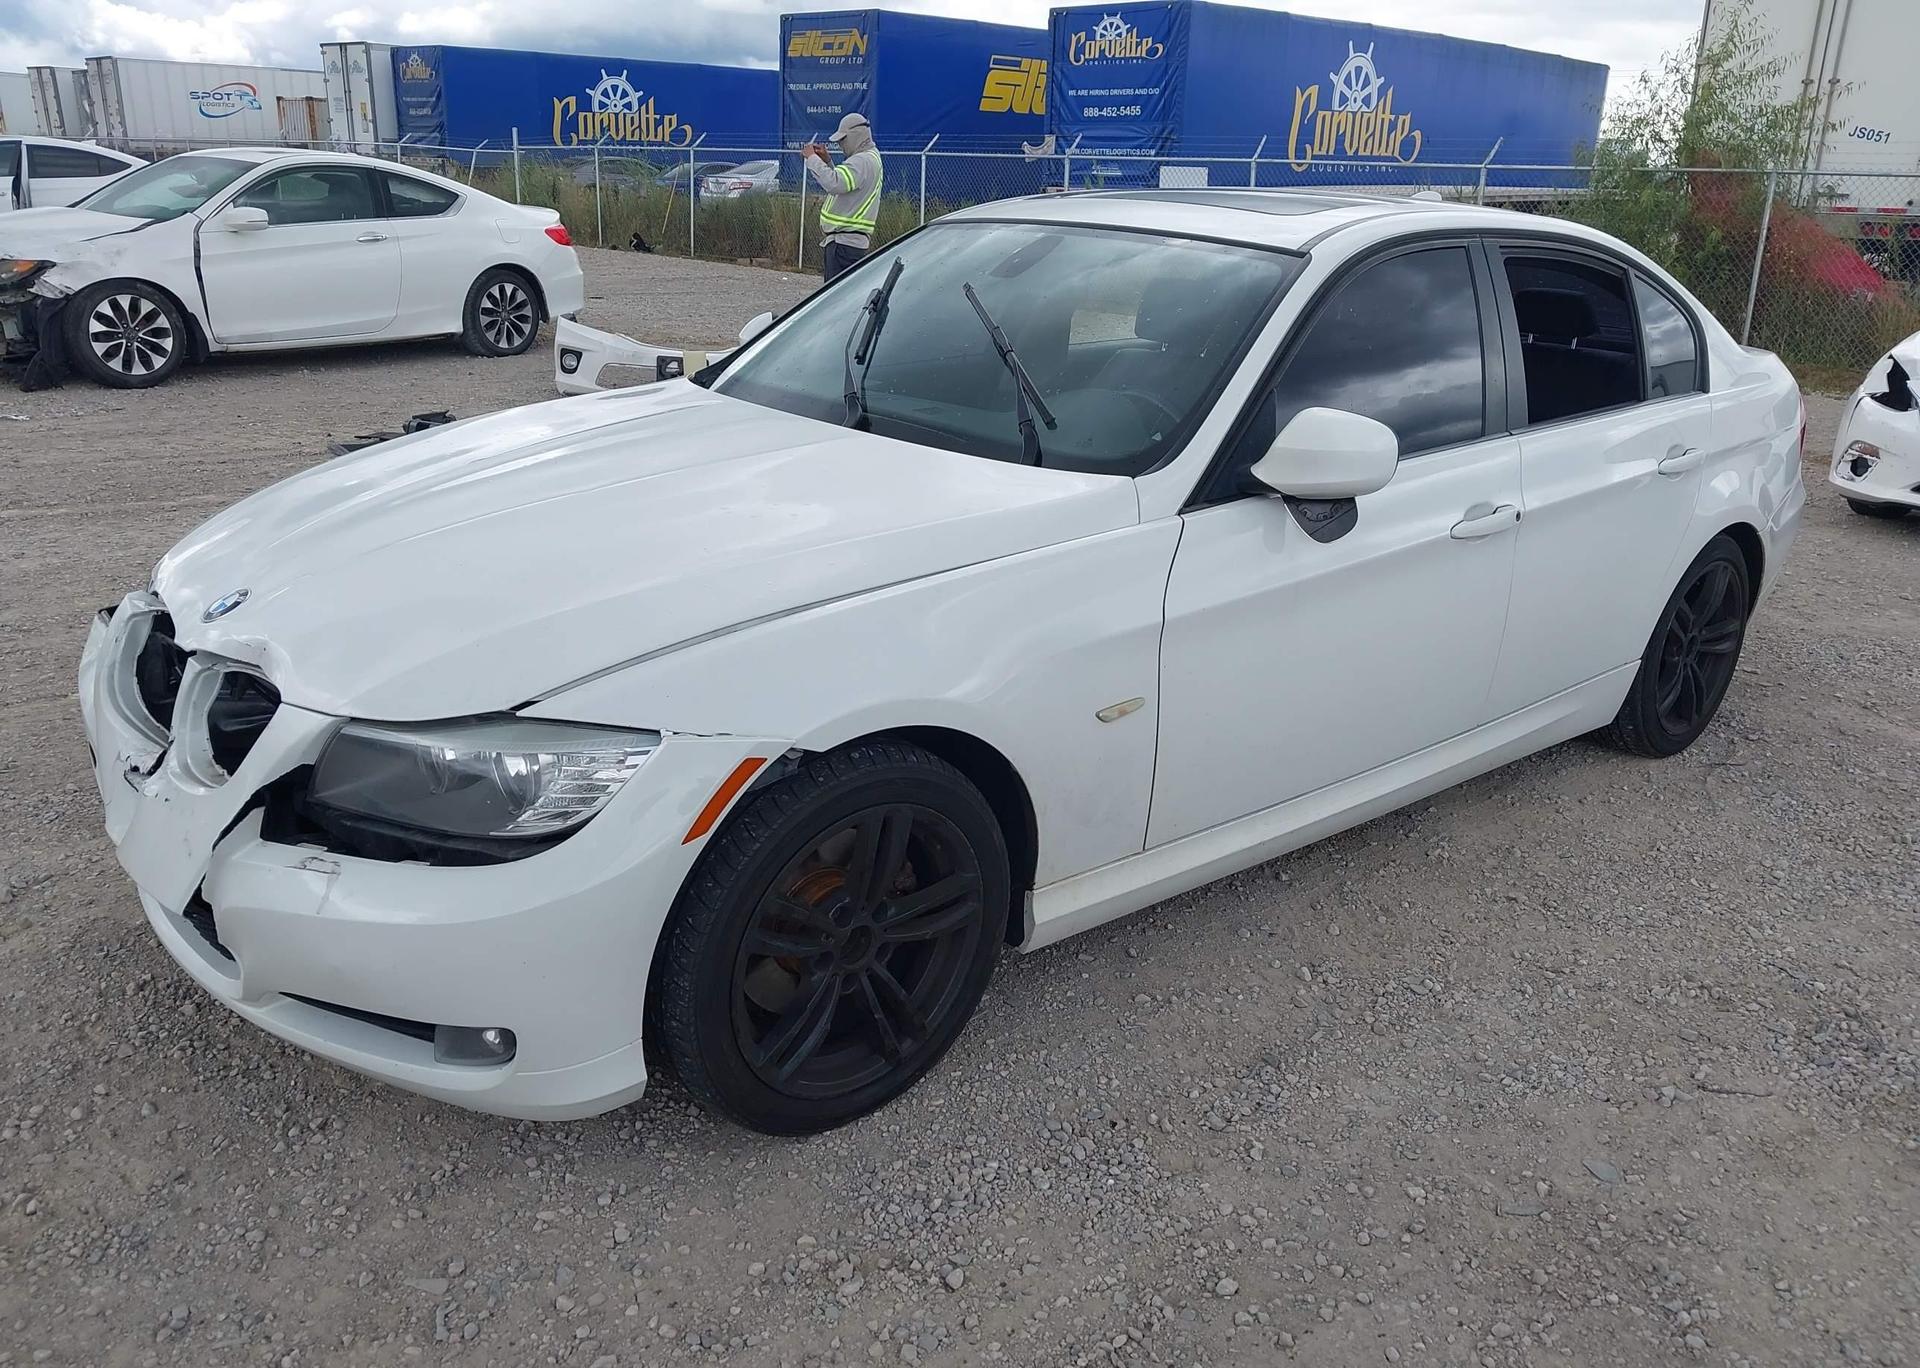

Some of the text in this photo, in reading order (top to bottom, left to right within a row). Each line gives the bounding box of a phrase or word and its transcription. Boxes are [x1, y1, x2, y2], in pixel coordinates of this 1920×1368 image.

[1069, 27, 1164, 65] Corvette
[813, 82, 841, 90] APPROVED
[841, 82, 853, 90] AND
[189, 91, 233, 101] SPOT
[1083, 106, 1142, 117] 888-452-5455
[553, 96, 692, 147] Corvette
[1288, 85, 1421, 172] Corvette
[1848, 126, 1891, 144] JS051
